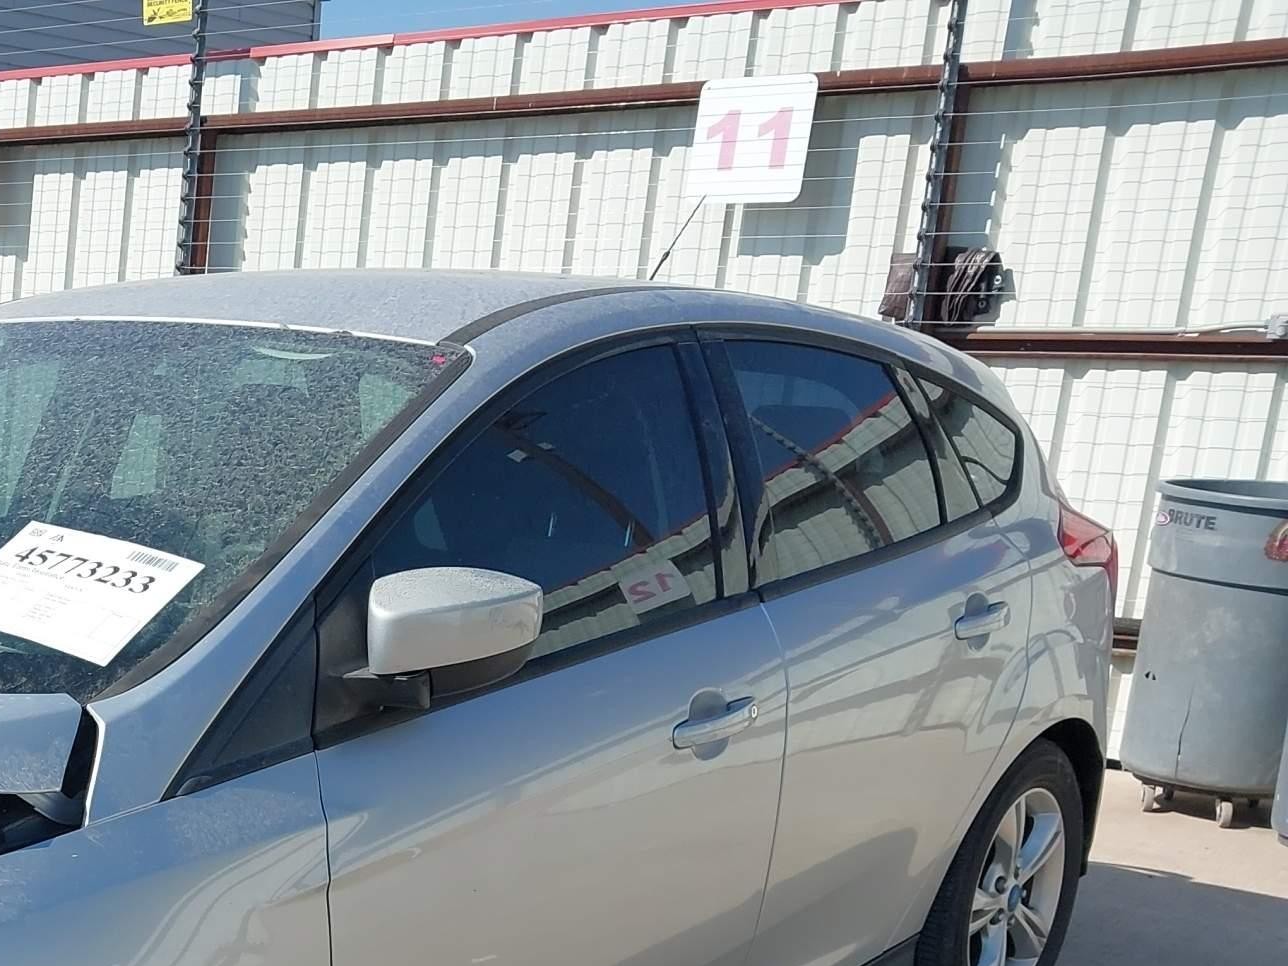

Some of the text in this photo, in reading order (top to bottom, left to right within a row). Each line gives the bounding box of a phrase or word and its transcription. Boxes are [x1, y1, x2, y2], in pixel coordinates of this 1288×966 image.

[706, 106, 794, 171] 11
[1168, 508, 1217, 531] BRUTE
[15, 546, 155, 594] 45773233
